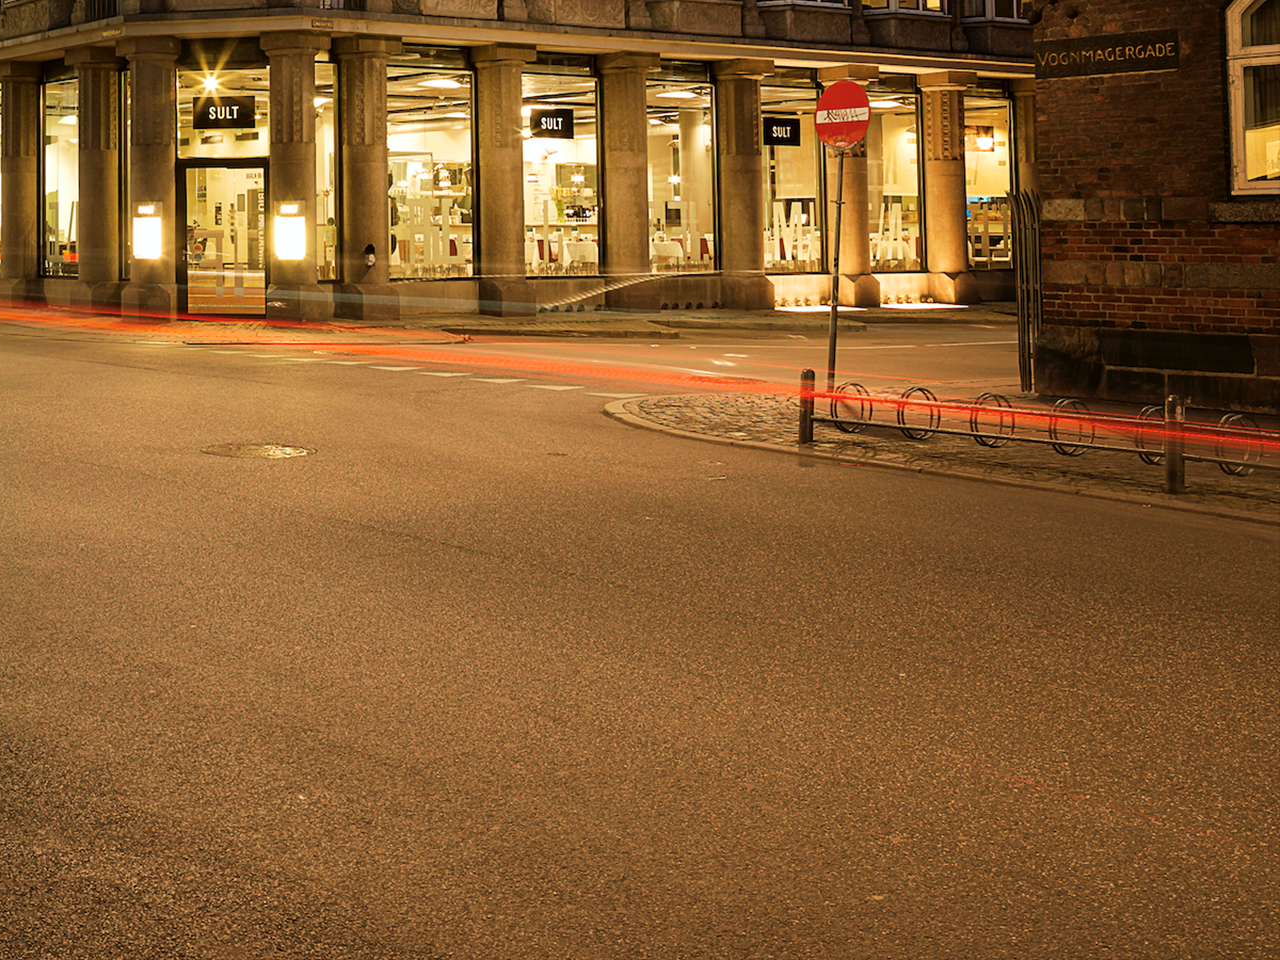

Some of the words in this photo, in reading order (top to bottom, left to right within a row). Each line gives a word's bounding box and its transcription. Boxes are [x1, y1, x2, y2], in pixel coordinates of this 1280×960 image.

[1037, 42, 1176, 67] VOGNMAGERGADE
[208, 105, 240, 120] SULT
[540, 116, 564, 131] SULT
[772, 125, 792, 139] SULT
